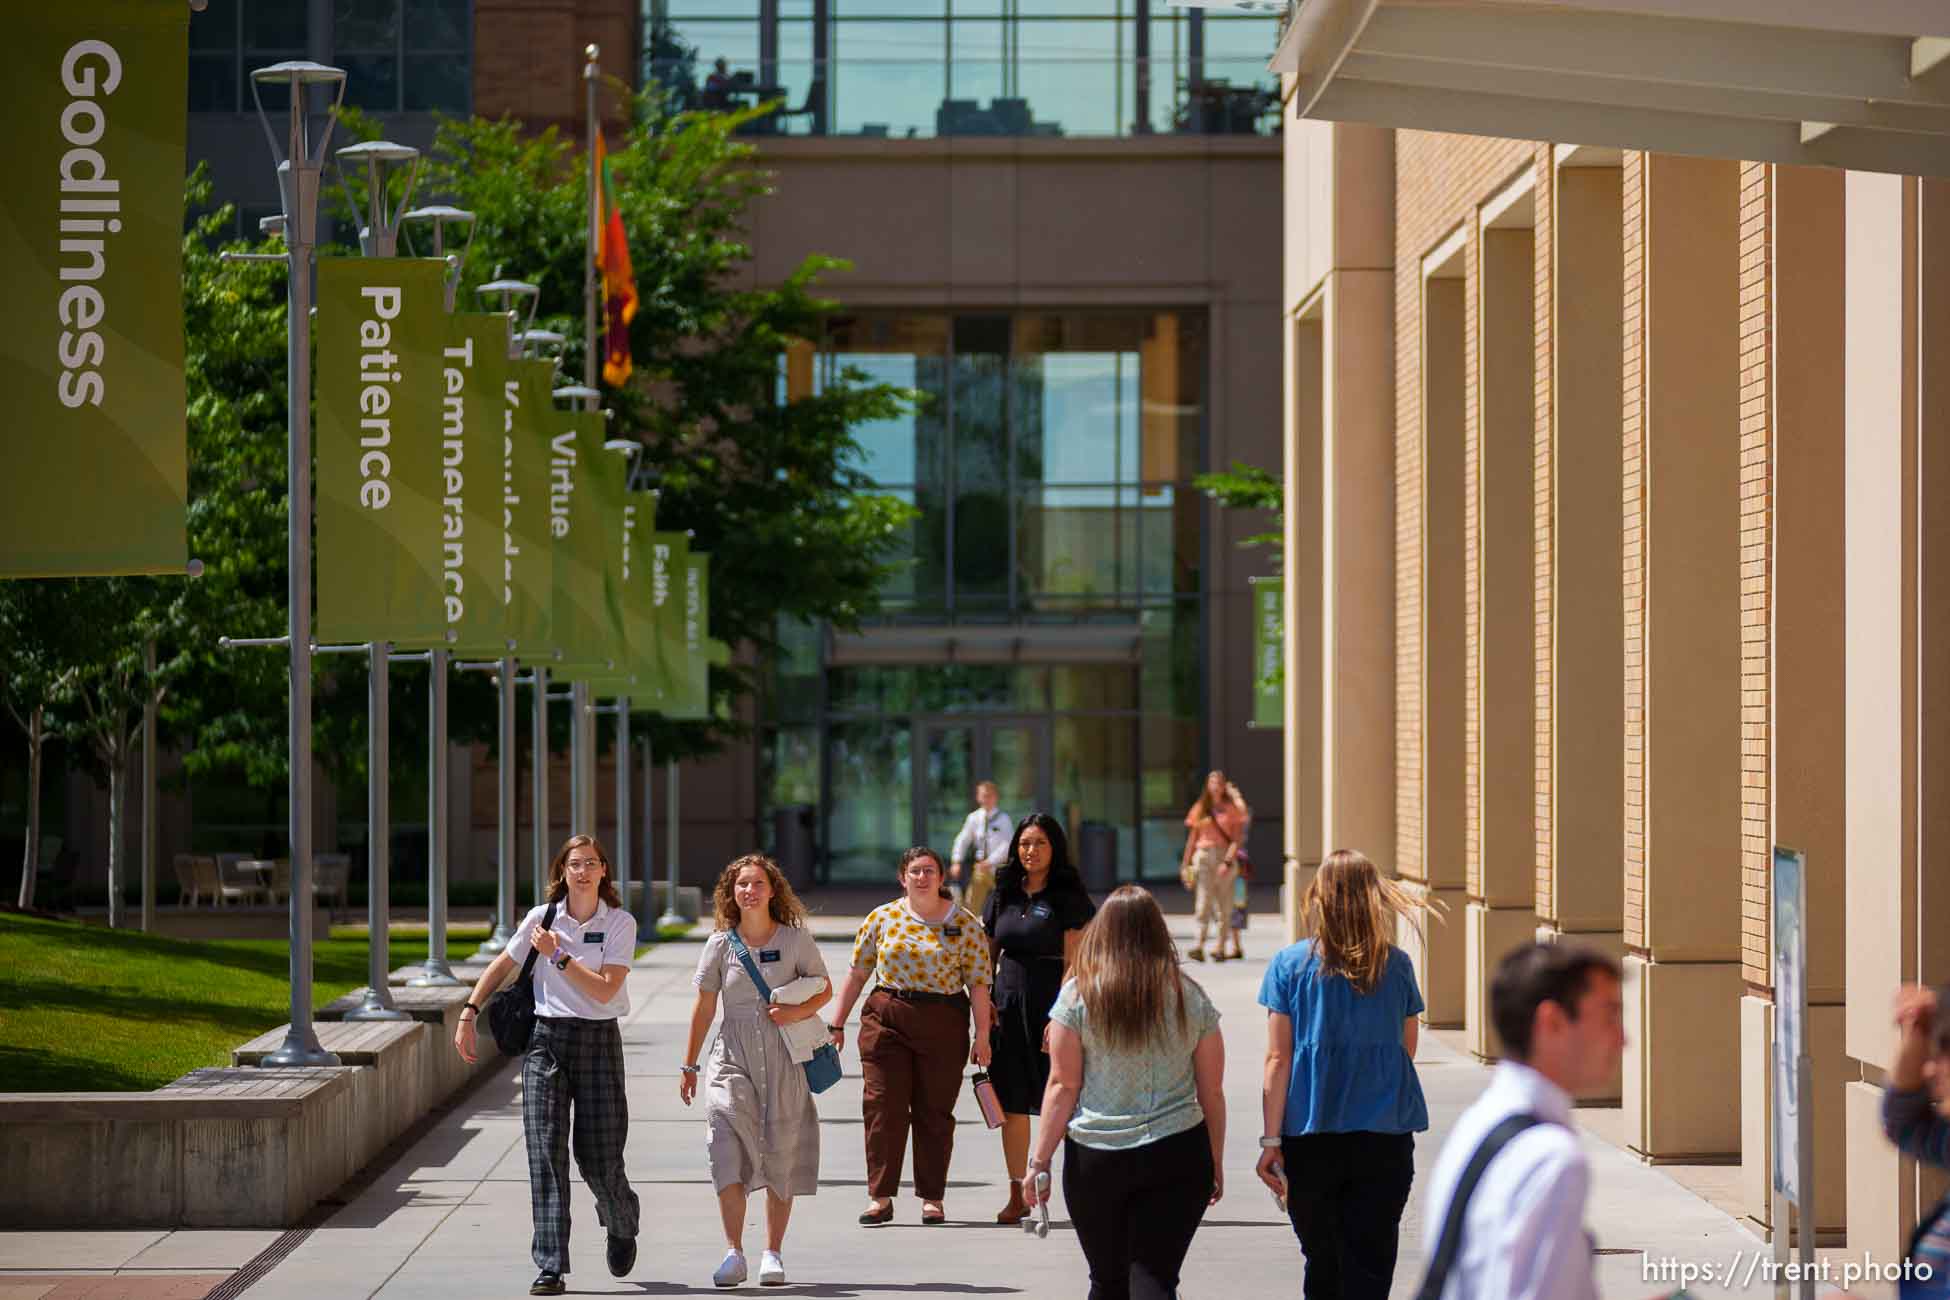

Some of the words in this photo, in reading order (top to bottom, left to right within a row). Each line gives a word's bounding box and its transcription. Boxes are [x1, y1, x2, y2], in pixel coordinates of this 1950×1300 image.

[58, 39, 123, 409] Godliness
[359, 286, 402, 510] Patience
[551, 430, 577, 538] Virtue
